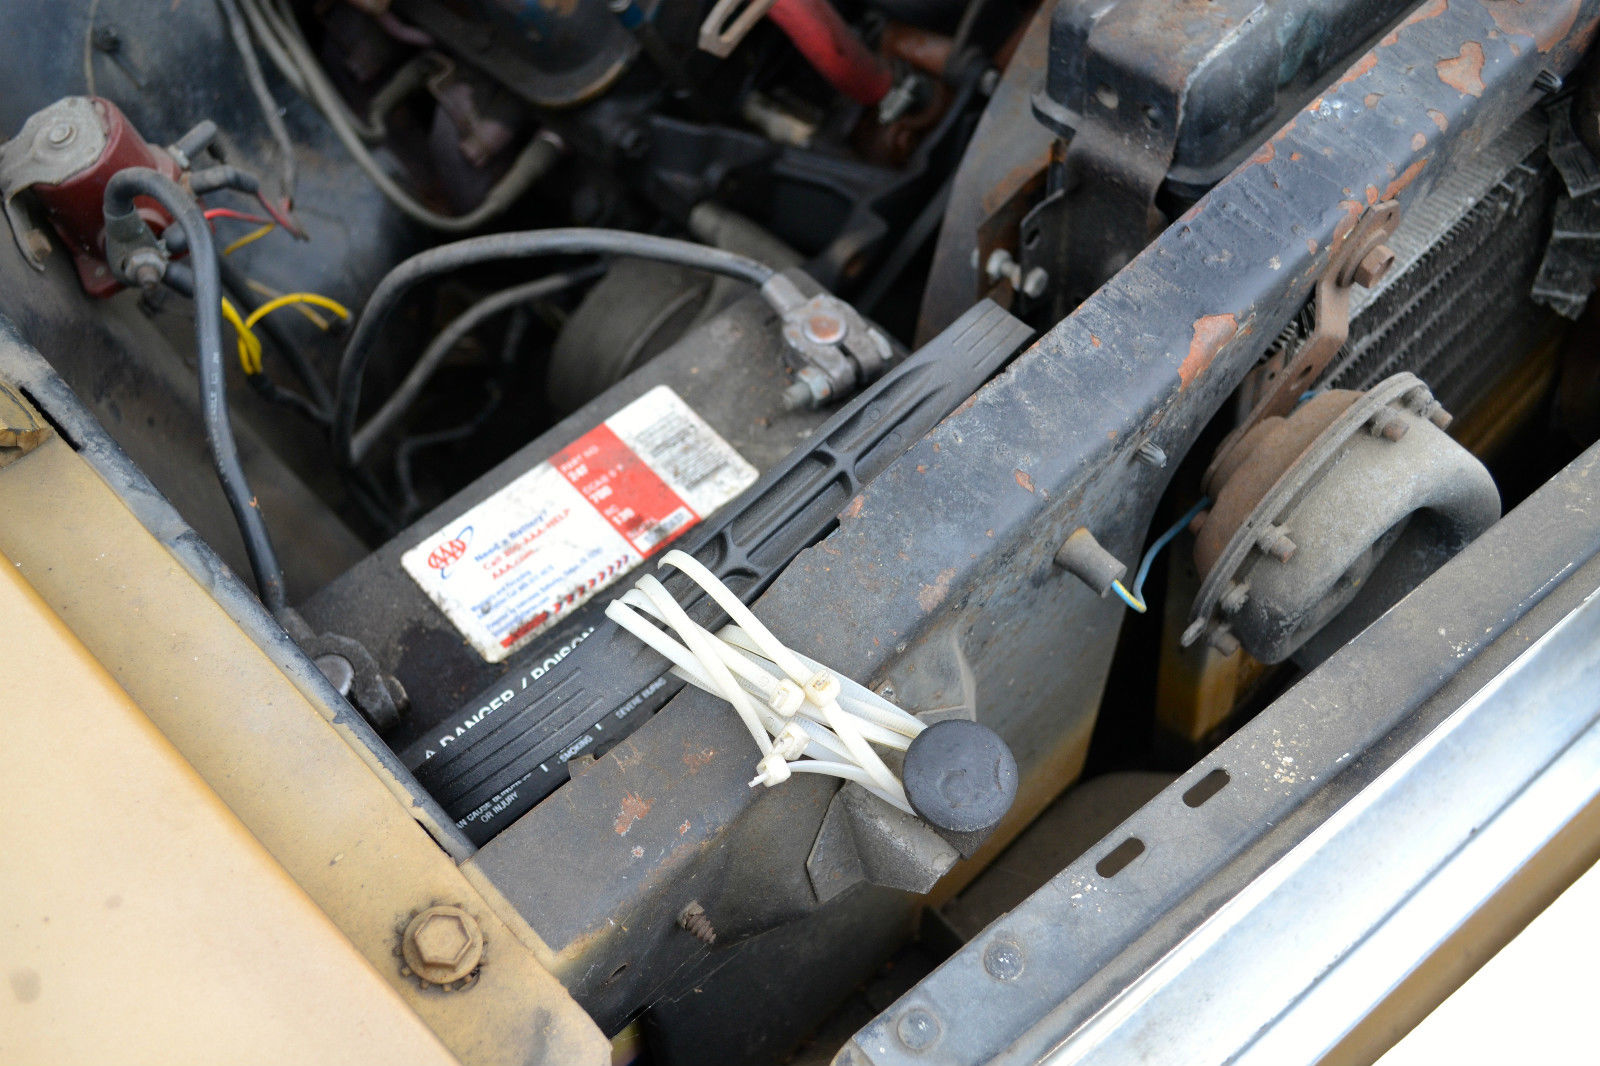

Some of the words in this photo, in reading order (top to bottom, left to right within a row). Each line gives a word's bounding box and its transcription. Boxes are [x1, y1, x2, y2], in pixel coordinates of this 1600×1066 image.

[427, 539, 466, 570] AAA
[439, 687, 516, 749] DANGER
[480, 810, 496, 825] OR
[493, 790, 520, 818] INJURY
